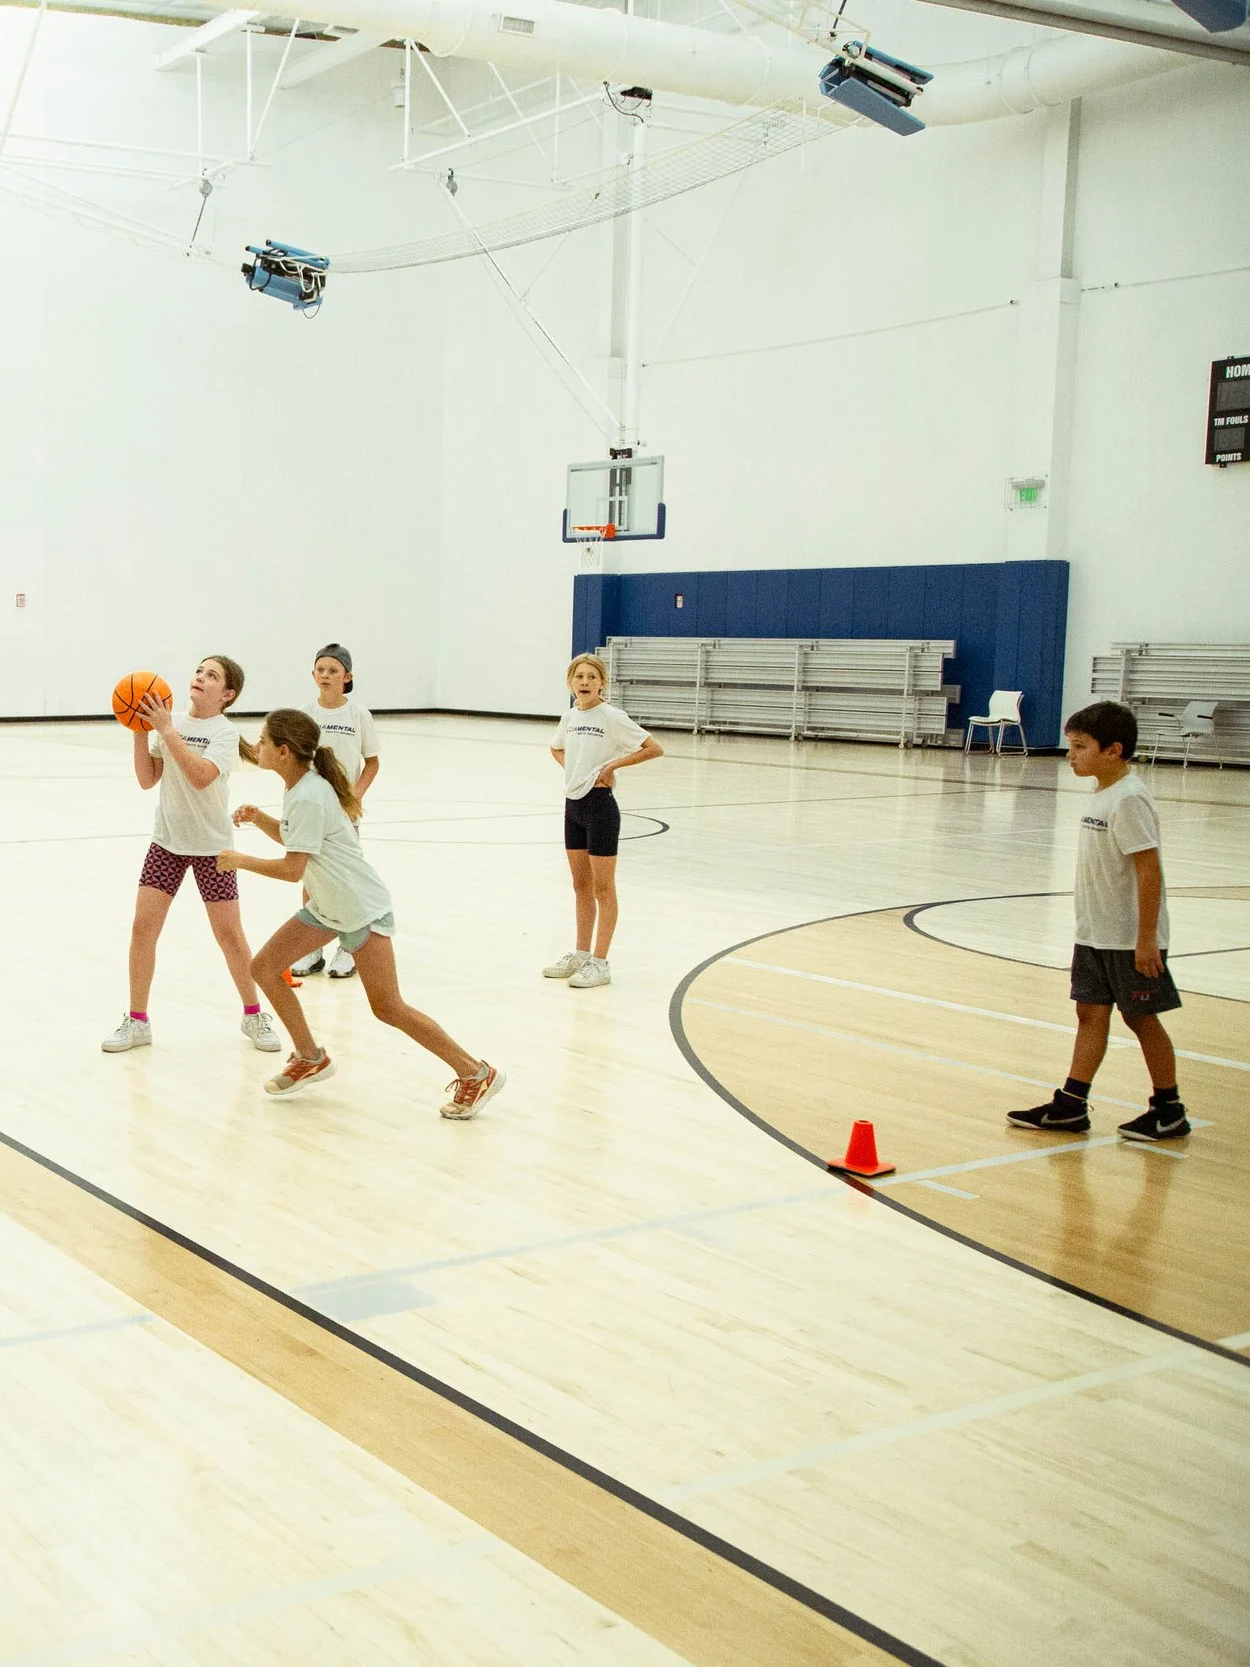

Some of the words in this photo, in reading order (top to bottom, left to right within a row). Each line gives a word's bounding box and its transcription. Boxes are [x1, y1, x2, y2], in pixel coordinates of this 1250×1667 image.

[1214, 418, 1225, 426] TM
[1226, 415, 1249, 425] FOULS
[1216, 453, 1242, 462] POINTS
